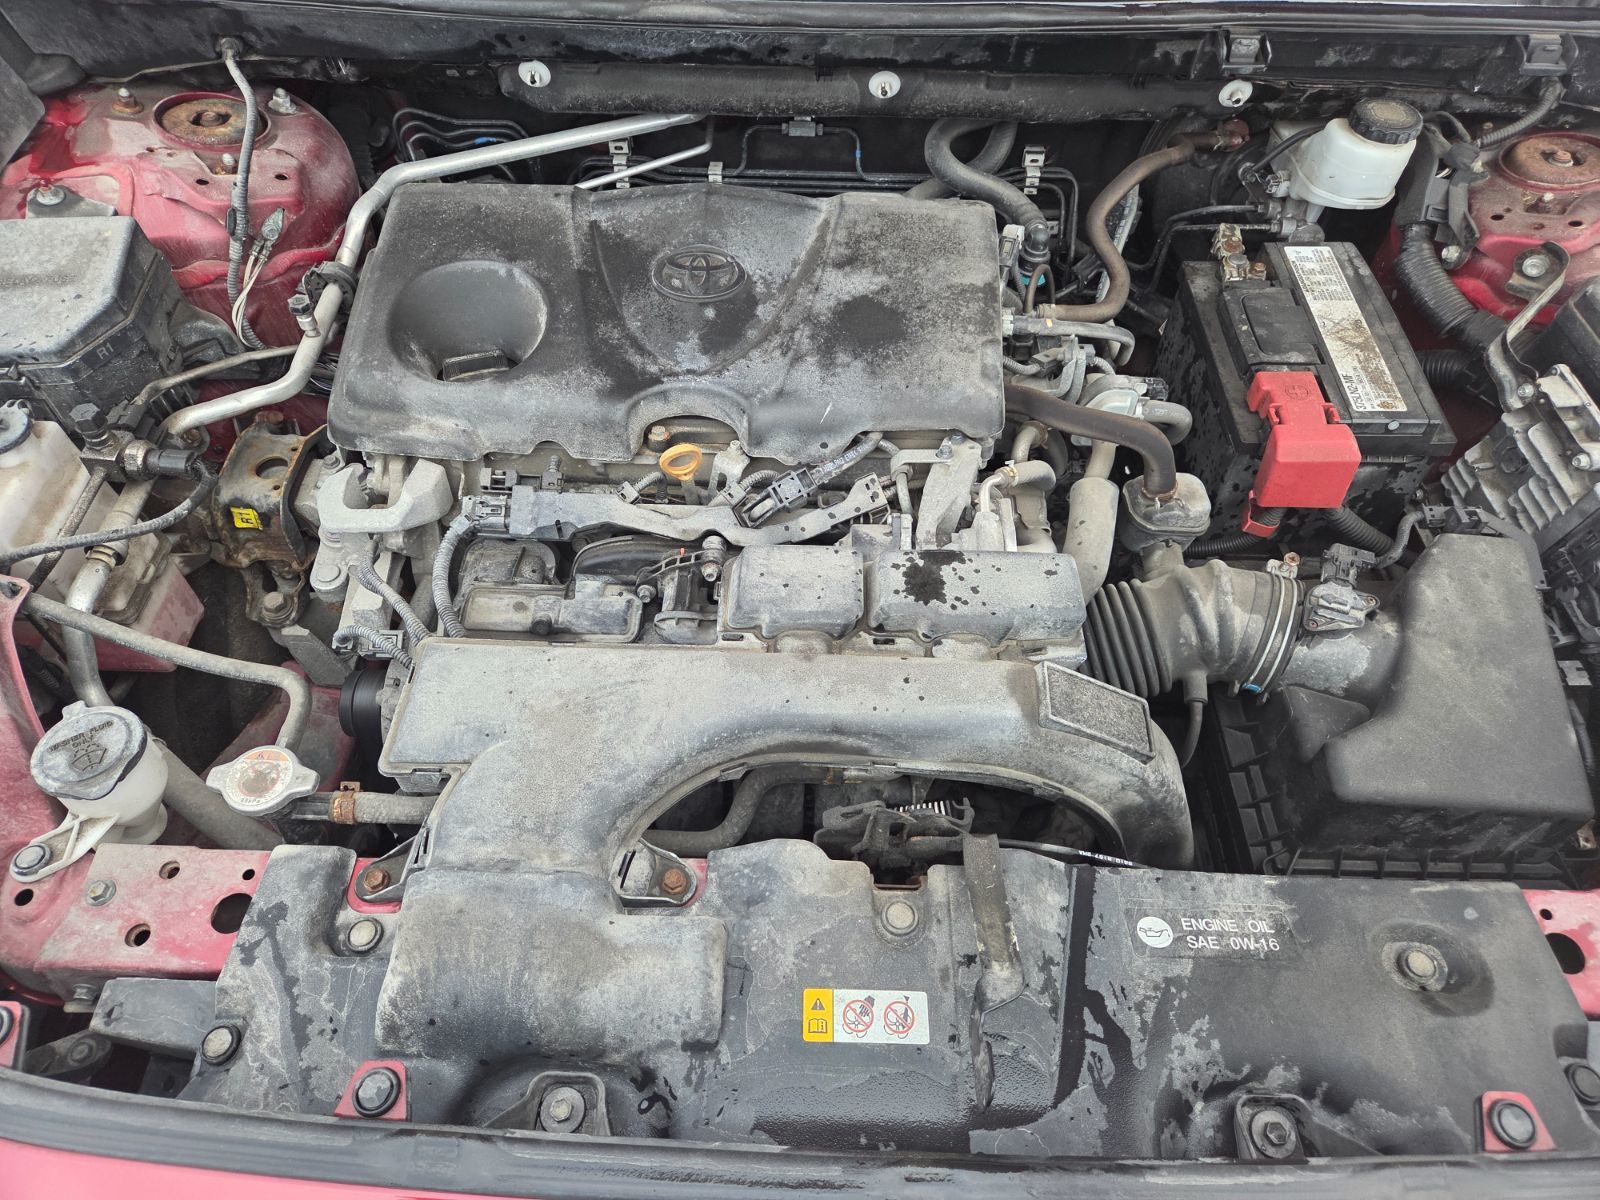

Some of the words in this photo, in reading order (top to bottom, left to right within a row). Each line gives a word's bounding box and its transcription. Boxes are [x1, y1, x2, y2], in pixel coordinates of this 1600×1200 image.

[96, 342, 114, 359] R1
[239, 511, 254, 524] R1
[48, 732, 85, 752] WASHER
[89, 720, 114, 735] FLUID
[72, 734, 94, 749] ONLY
[1181, 918, 1238, 931] ENGINE
[1248, 920, 1275, 933] OIL
[1187, 936, 1219, 949] SAE
[1230, 938, 1280, 951] 0W-16
